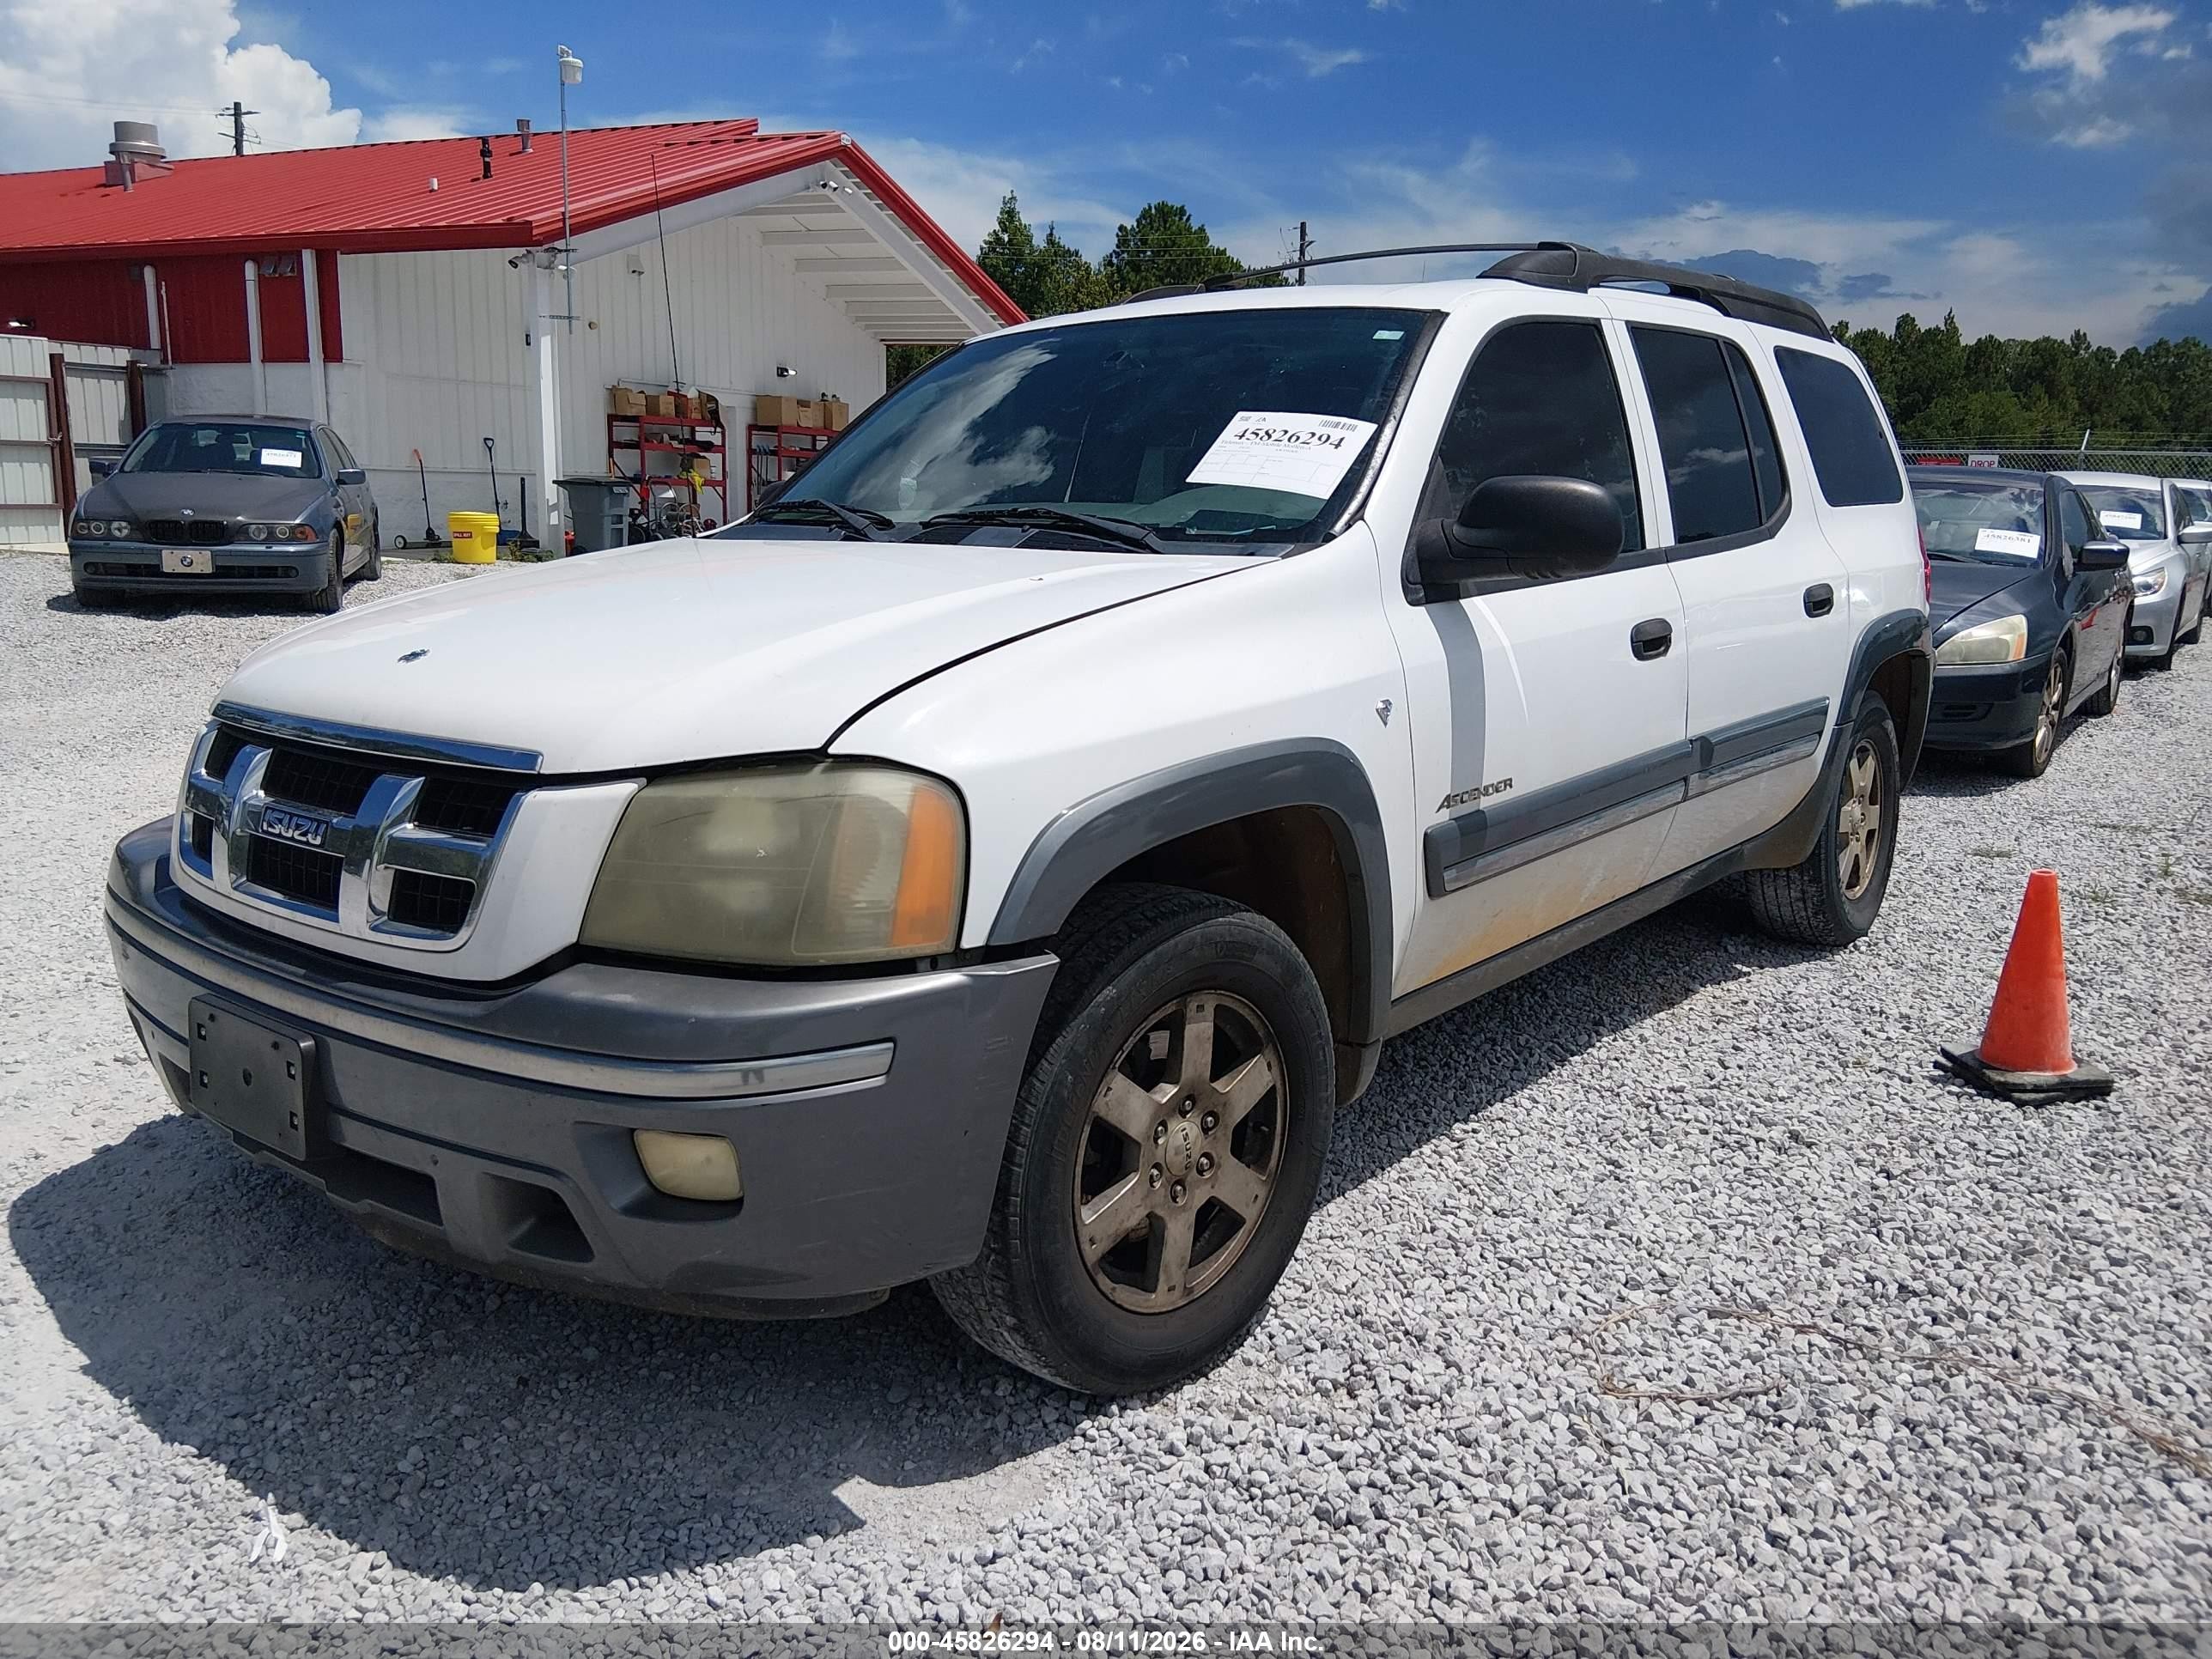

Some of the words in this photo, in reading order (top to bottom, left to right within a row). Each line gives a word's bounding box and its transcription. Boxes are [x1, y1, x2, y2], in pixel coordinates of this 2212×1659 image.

[1234, 428, 1346, 450] 45826294
[1436, 777, 1513, 813] ASCENDER
[262, 810, 327, 846] ISUZU
[1181, 1127, 1192, 1171] ISUZU
